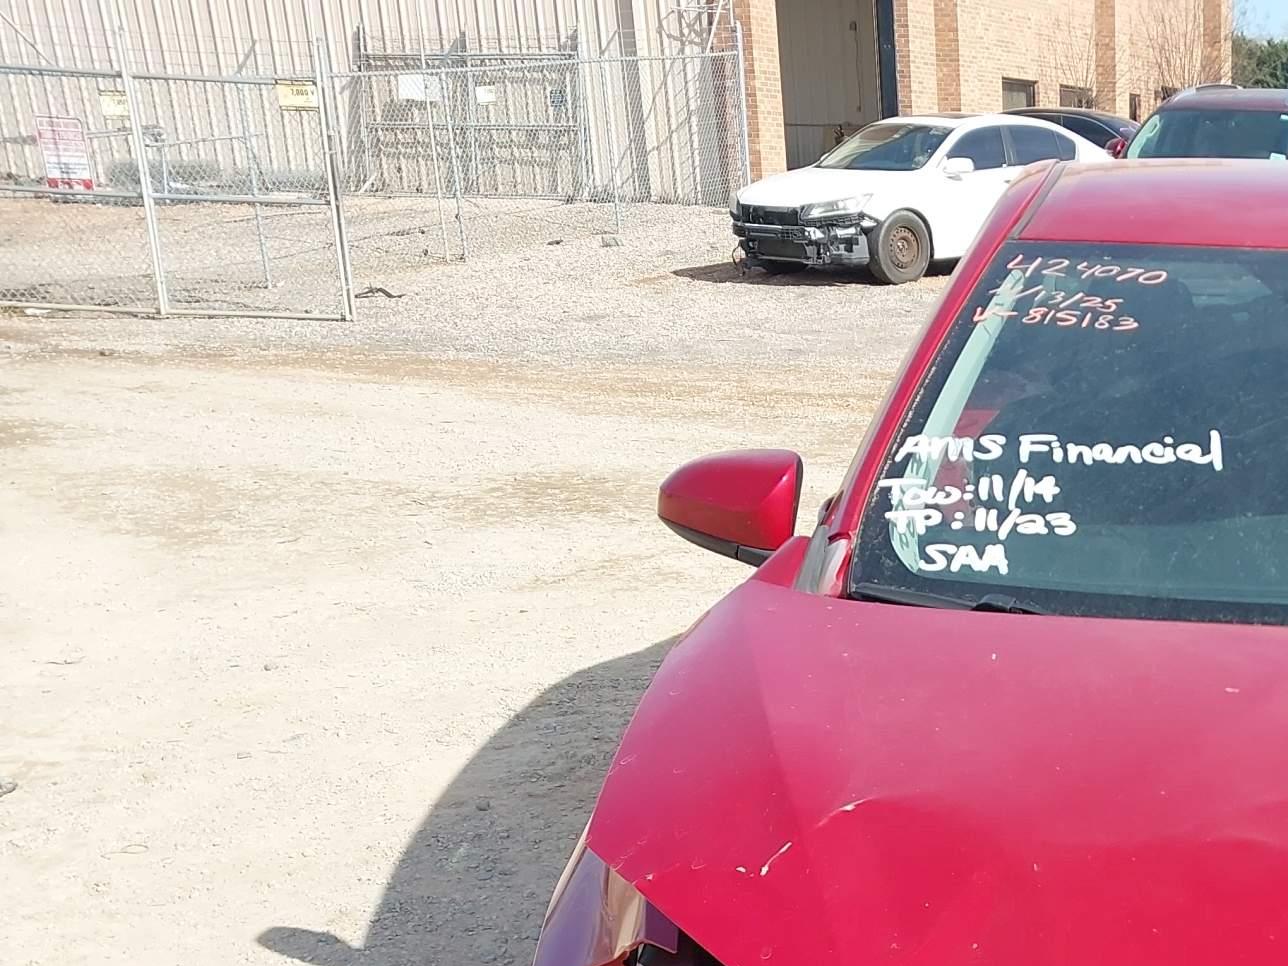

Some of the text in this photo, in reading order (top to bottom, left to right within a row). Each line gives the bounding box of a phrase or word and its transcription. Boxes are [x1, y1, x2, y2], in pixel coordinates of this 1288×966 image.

[1006, 254, 1168, 285] 424070
[1018, 430, 1224, 471] Financial
[918, 543, 1009, 576] SAA
